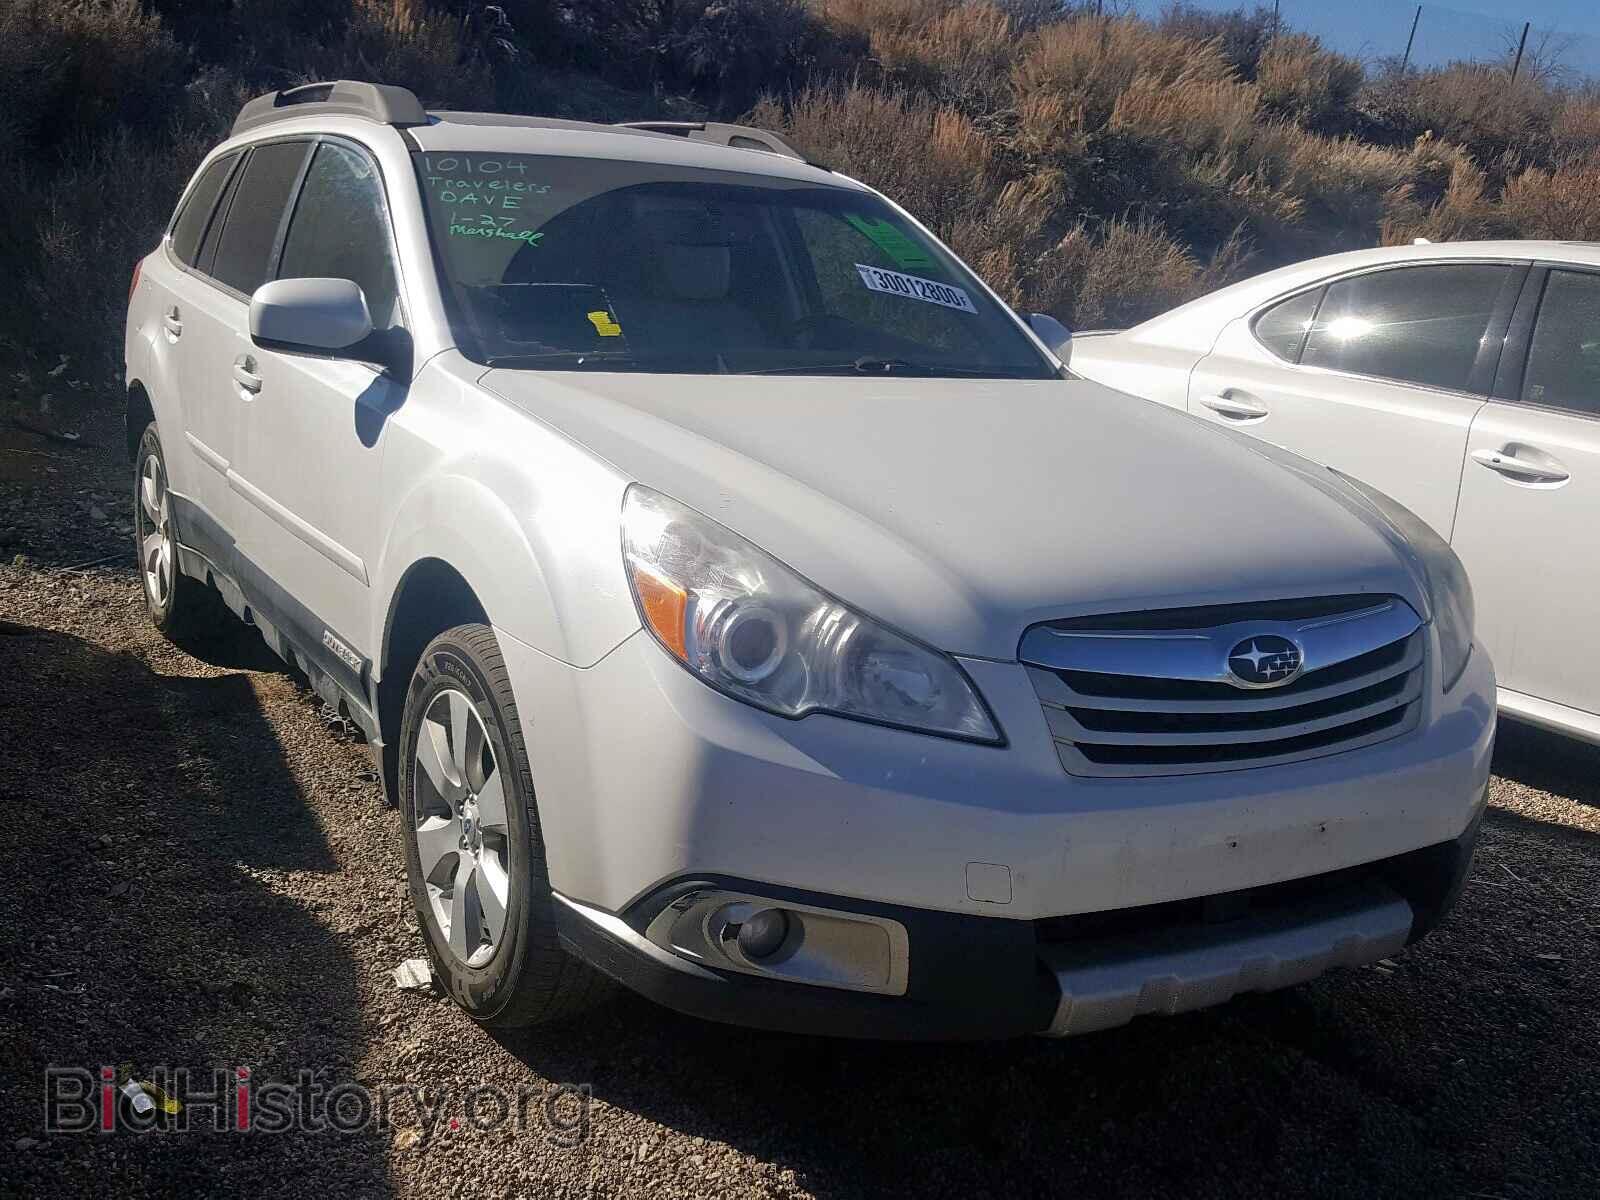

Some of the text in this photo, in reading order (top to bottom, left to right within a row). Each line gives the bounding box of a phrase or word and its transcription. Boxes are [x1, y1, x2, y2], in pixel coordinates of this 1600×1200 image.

[424, 157, 528, 174] 10104
[428, 176, 551, 194] Travelers
[440, 191, 523, 209] DAVE
